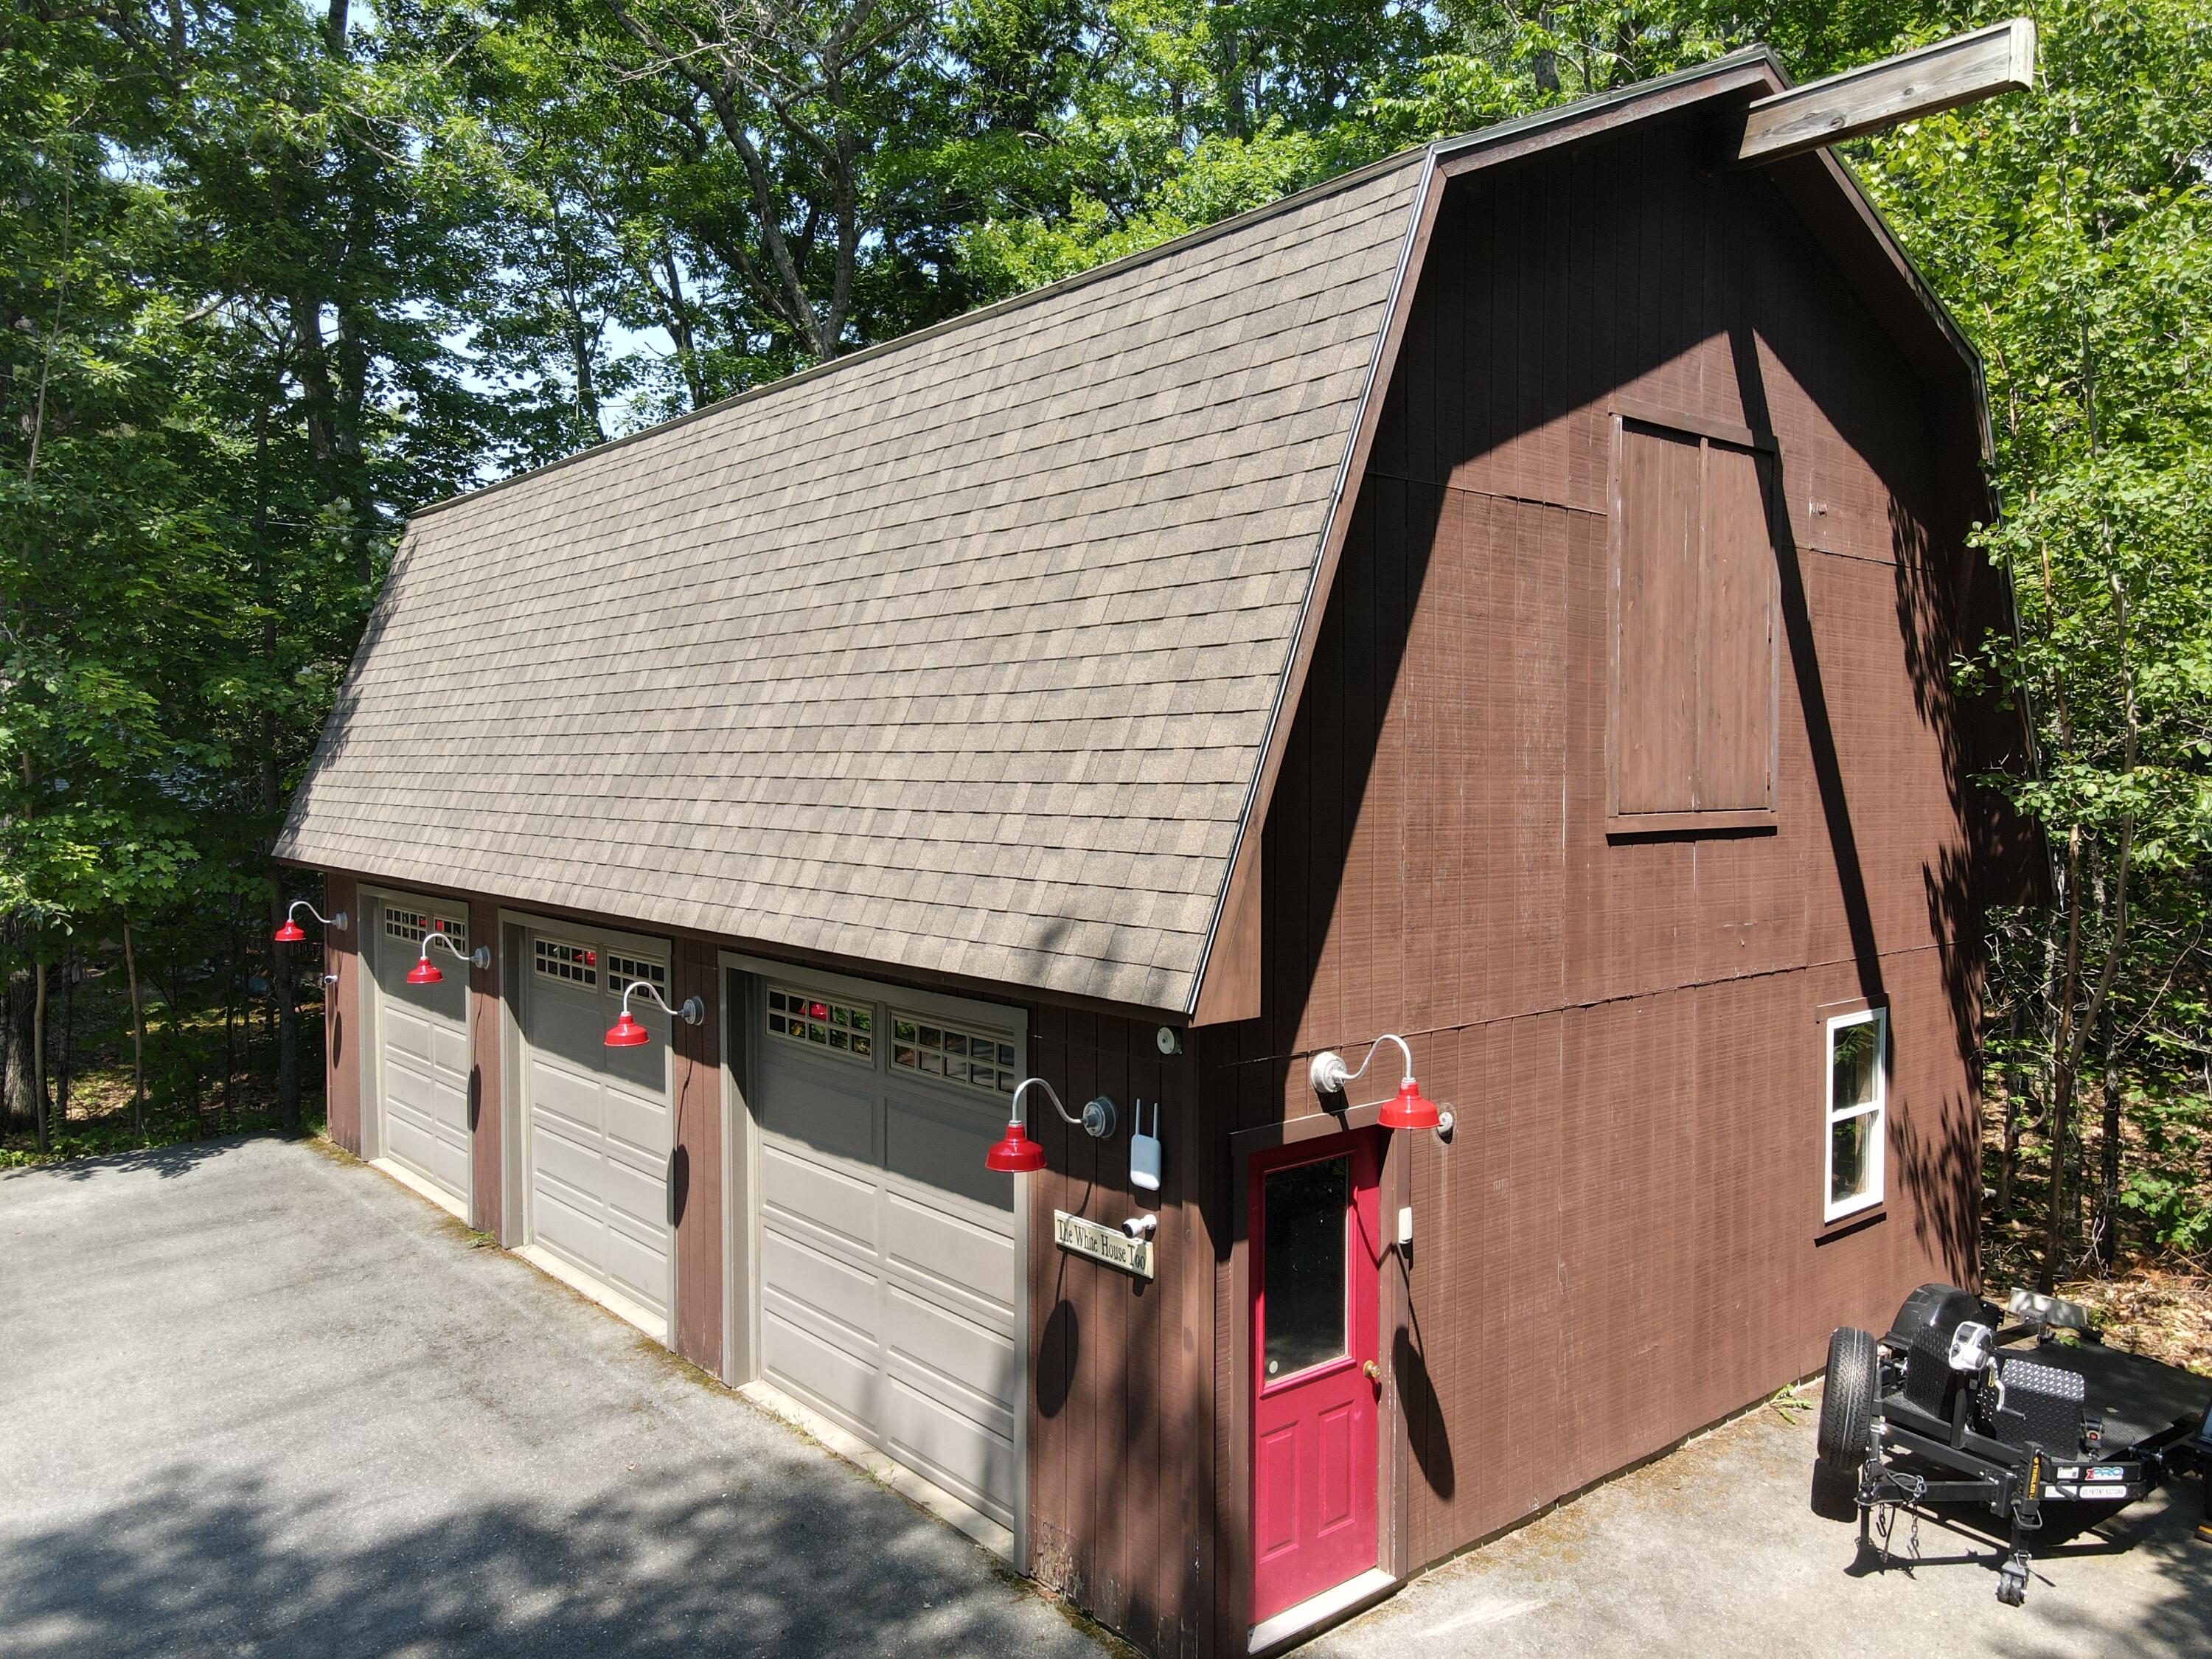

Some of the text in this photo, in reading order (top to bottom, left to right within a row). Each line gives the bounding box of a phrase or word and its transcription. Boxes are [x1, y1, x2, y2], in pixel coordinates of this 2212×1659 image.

[1057, 1219, 1146, 1270] The White House Too
